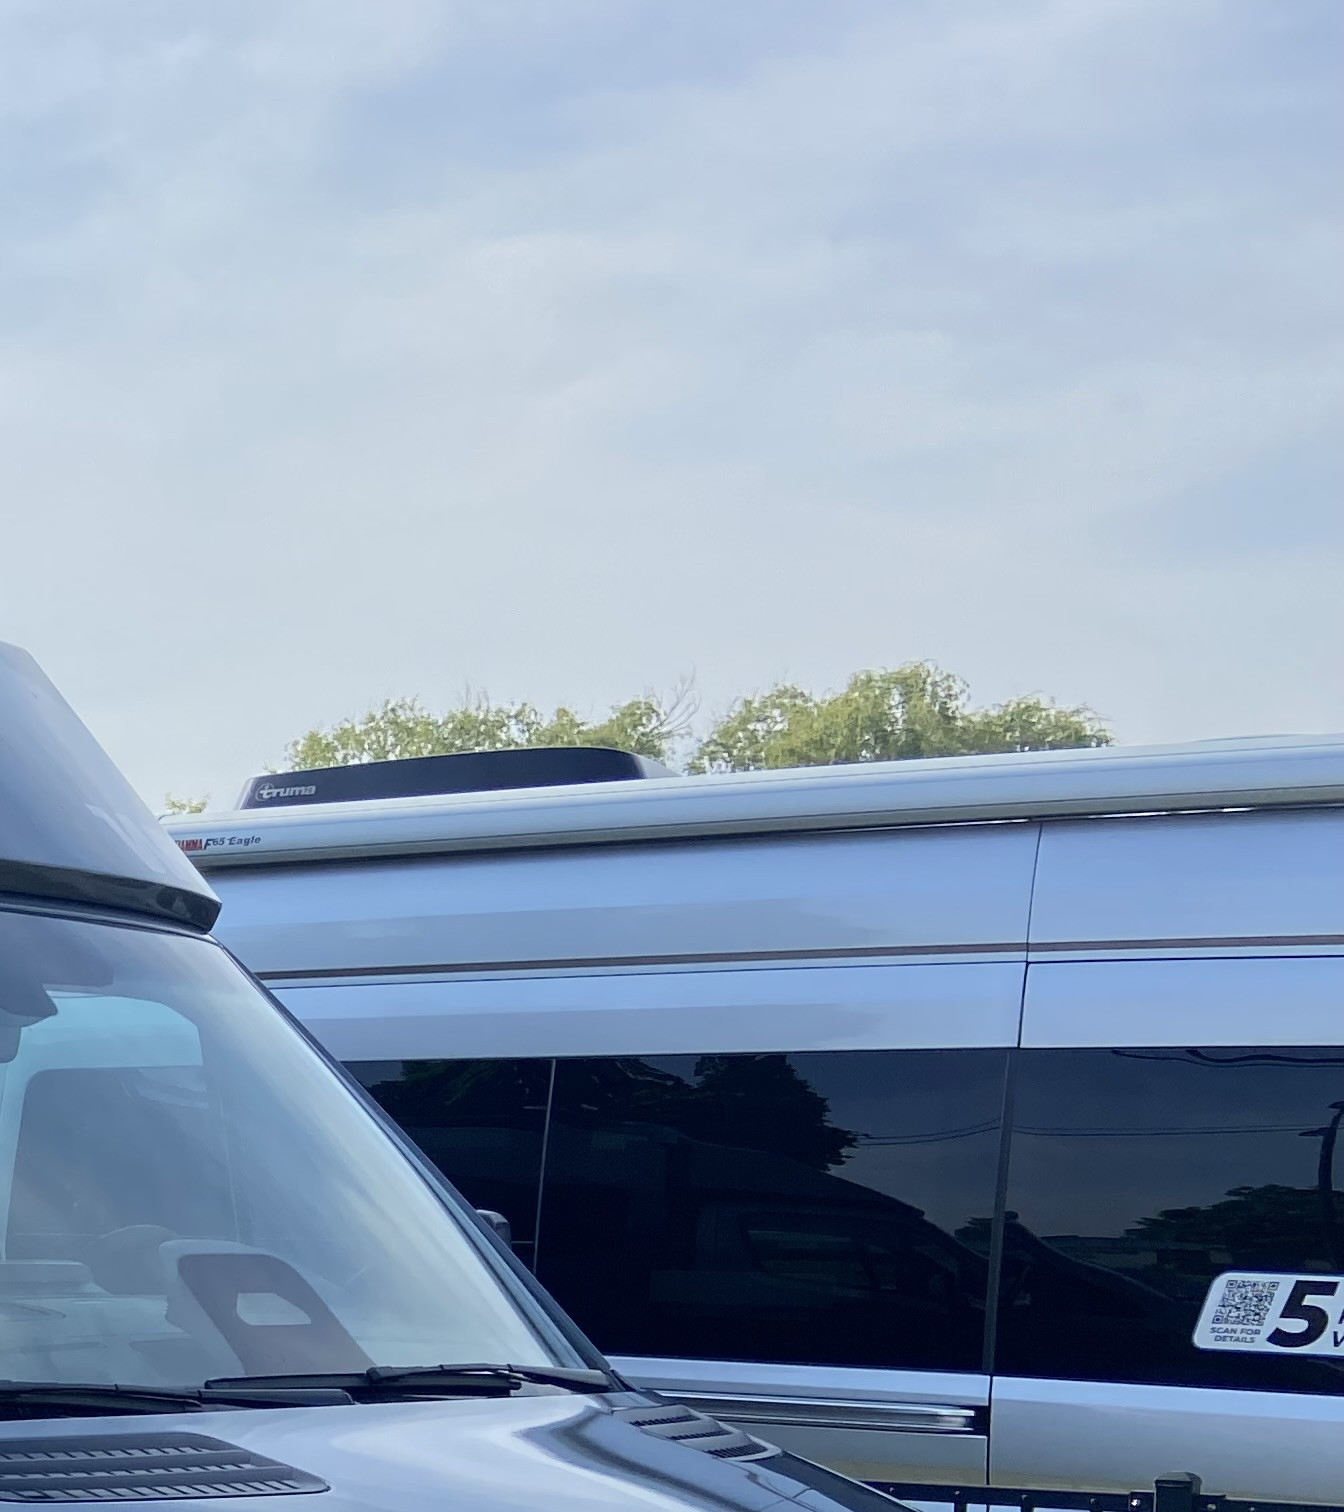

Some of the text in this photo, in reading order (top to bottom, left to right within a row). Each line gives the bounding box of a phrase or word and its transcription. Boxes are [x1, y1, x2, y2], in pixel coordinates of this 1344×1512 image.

[259, 784, 316, 799] truma
[227, 835, 262, 847] Eagle
[1265, 1279, 1340, 1348] 5
[1210, 1326, 1261, 1335] SCAN FOR
[1214, 1335, 1255, 1343] DETAILS
